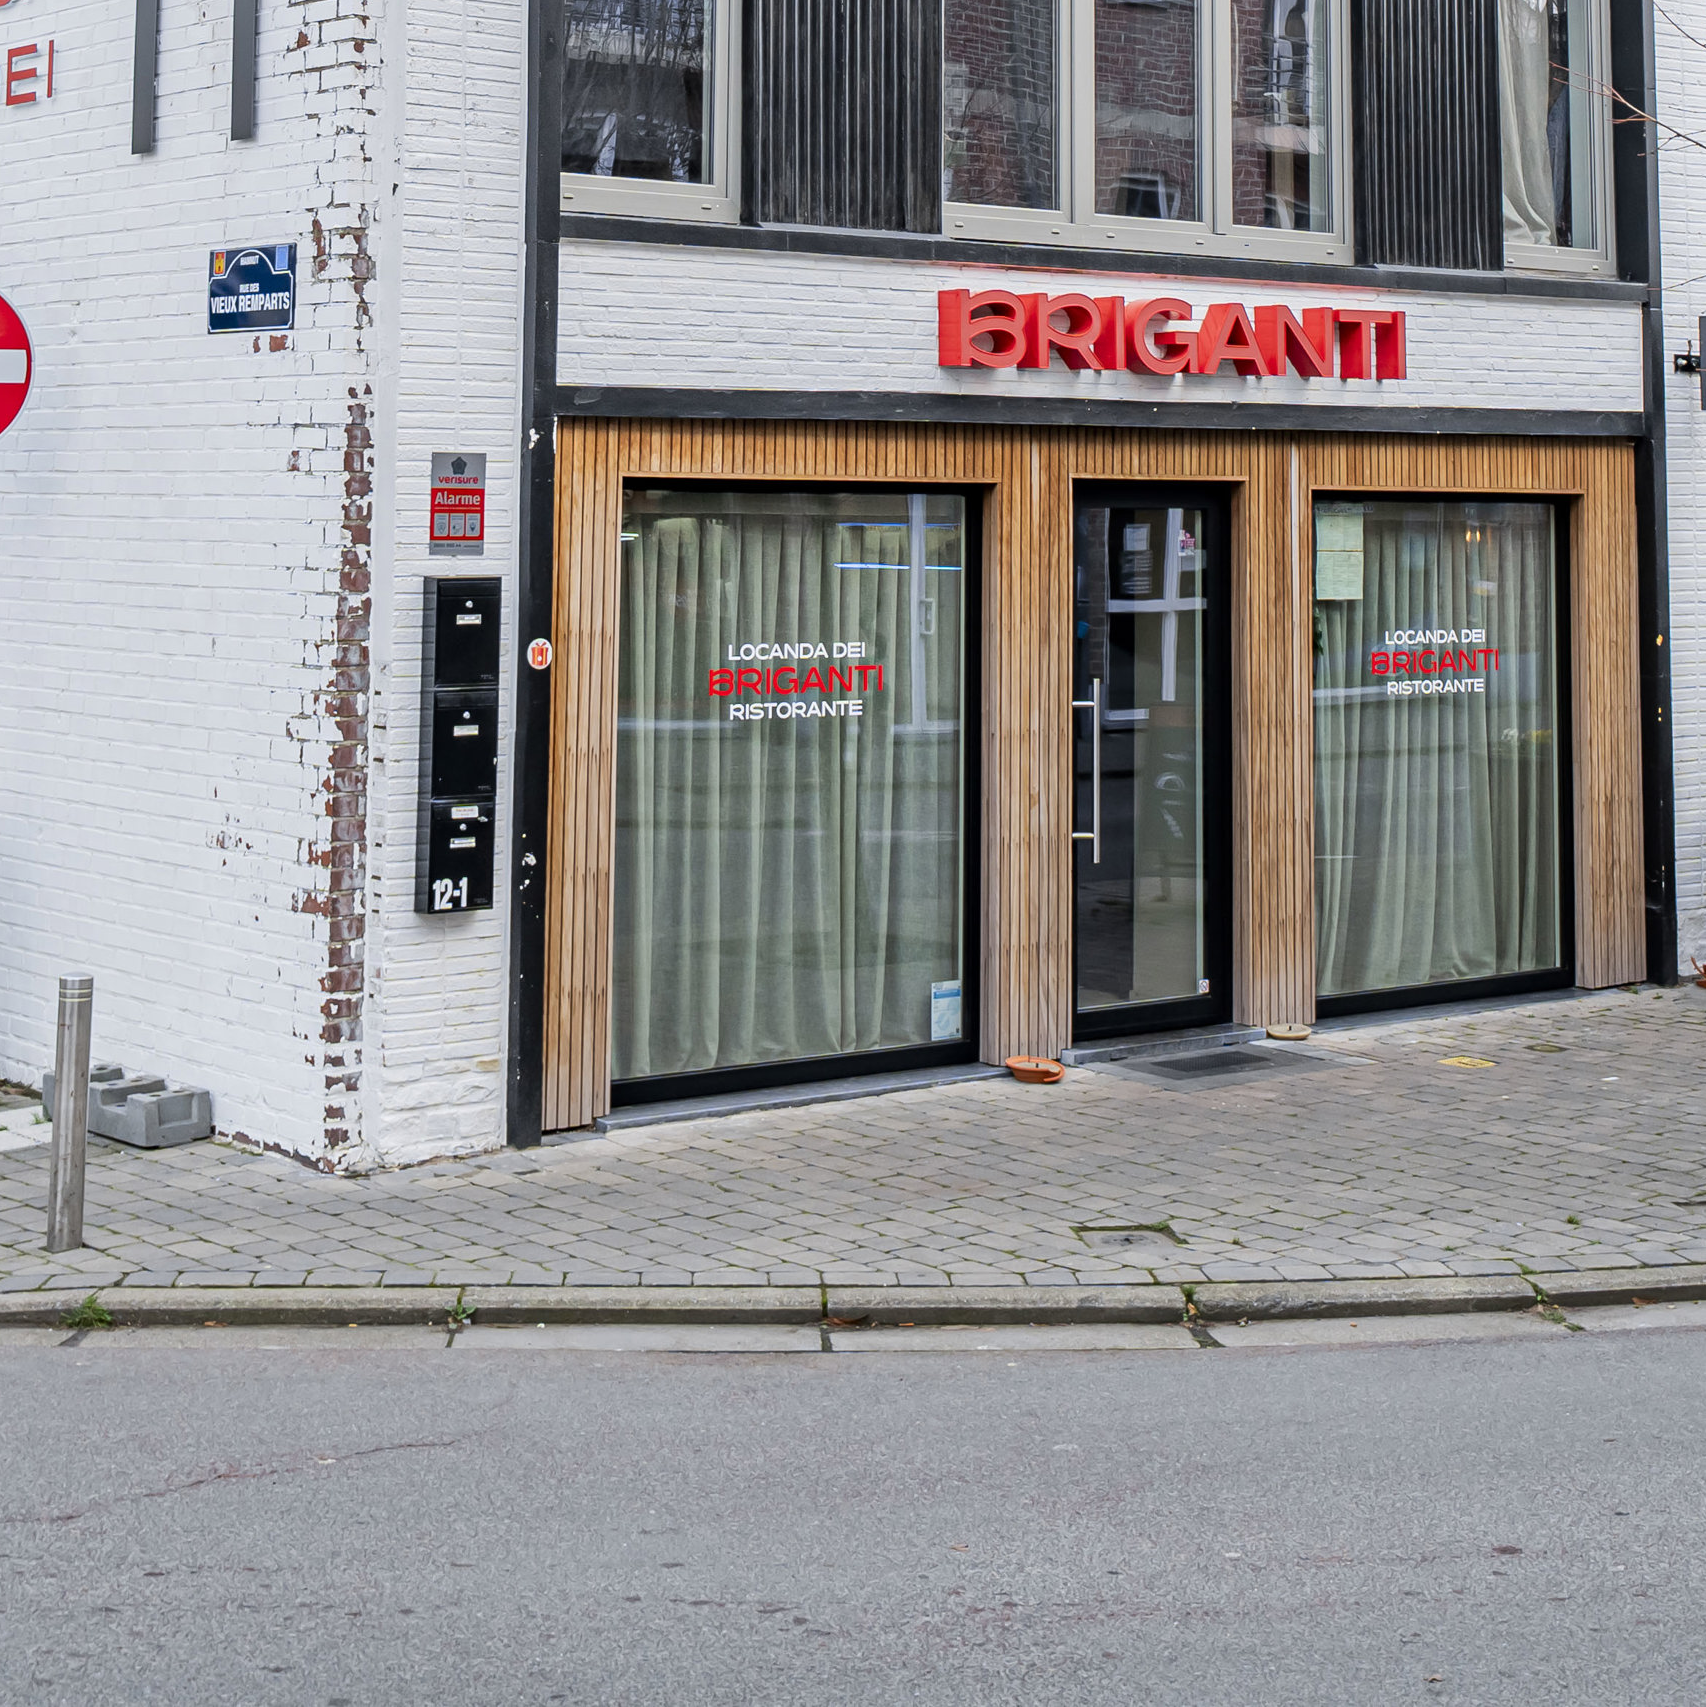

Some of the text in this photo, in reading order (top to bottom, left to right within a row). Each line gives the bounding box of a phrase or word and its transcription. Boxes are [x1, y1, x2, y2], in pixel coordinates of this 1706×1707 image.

[210, 291, 290, 314] VIEUX REMPARTS
[938, 288, 1406, 381] BRIGANTI
[438, 476, 479, 484] verisure
[434, 491, 481, 505] Alarme
[1385, 629, 1485, 645] LOCANDA DEI
[728, 641, 866, 661] LOCANDA DEI
[1371, 649, 1499, 675] BRIGANTI
[708, 664, 884, 697] BRIGANTI
[1387, 678, 1484, 695] RISTORANTE
[729, 699, 863, 721] RISTORANTE
[432, 876, 468, 910] 12-1
